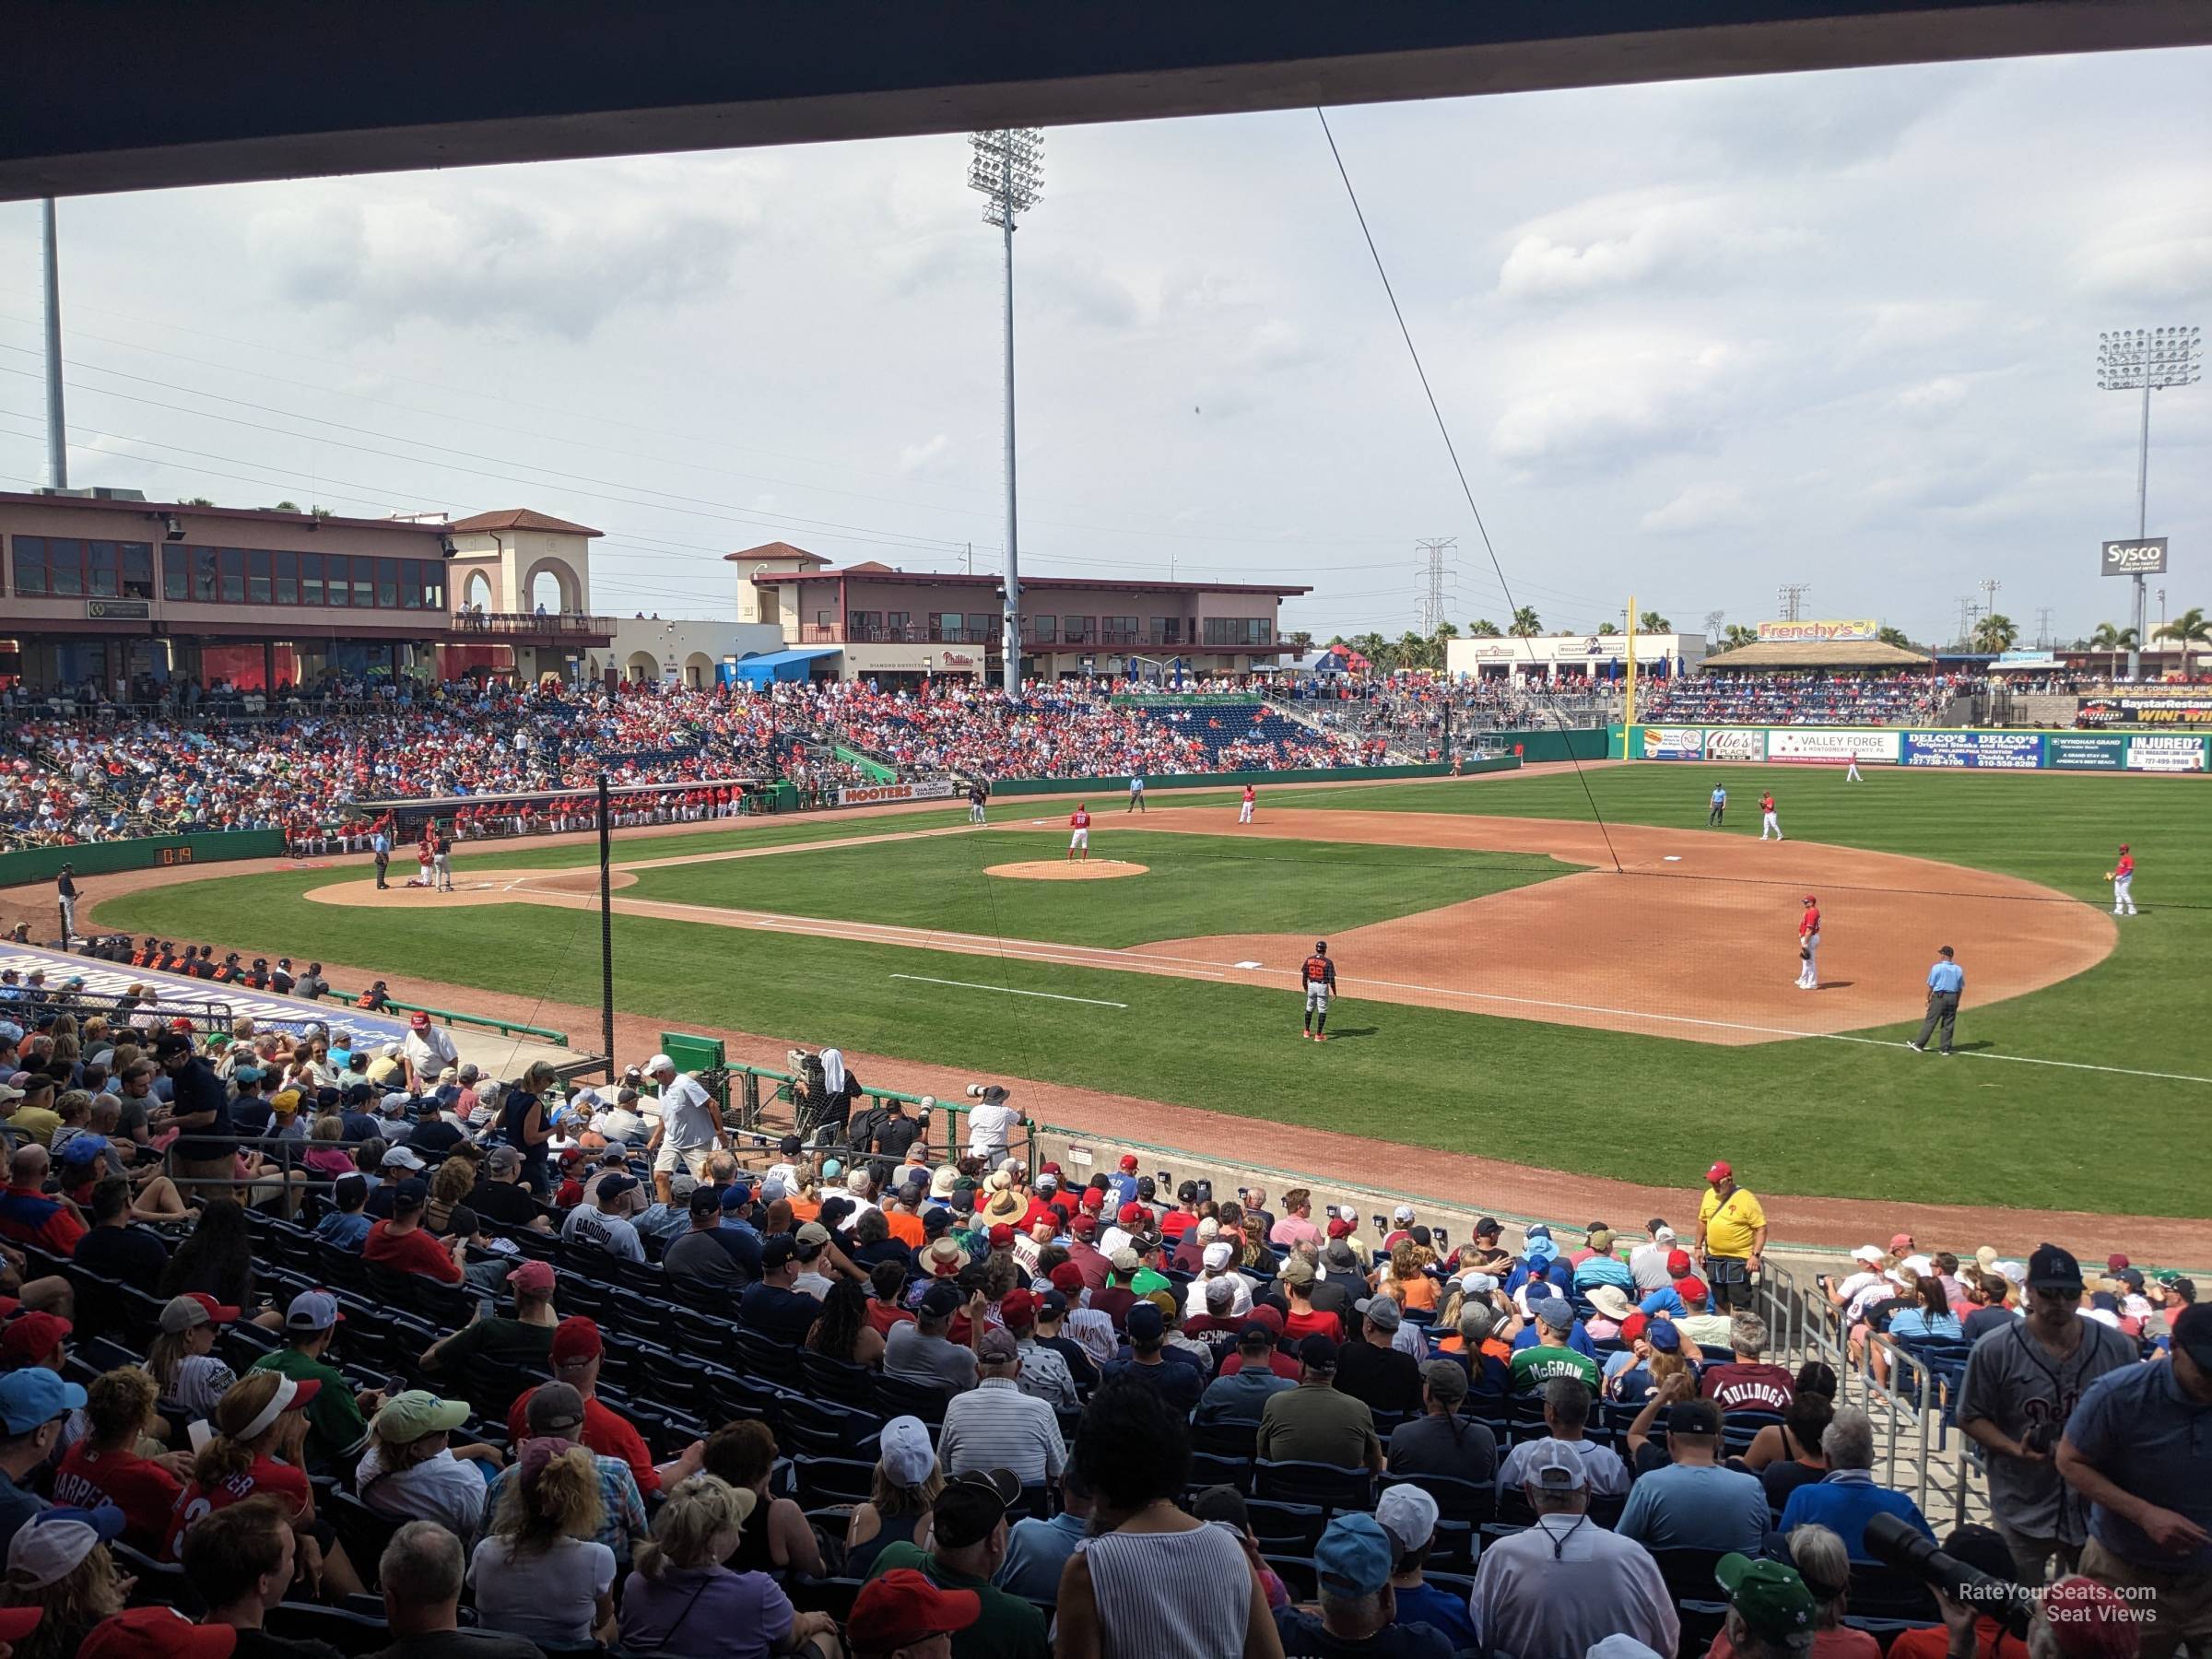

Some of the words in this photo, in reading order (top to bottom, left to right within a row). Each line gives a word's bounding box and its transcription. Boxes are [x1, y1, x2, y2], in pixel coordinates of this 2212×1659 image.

[2108, 545, 2160, 565] Sysco
[1759, 623, 1853, 639] Frenchy's
[942, 651, 974, 665] Phillies
[1707, 730, 1750, 748] Abe's
[1802, 736, 1843, 746] VALLEY
[1847, 737, 1884, 747] FORGE
[1909, 734, 1966, 743] DELCO'S
[1978, 735, 2039, 744] DELCO'S
[2132, 737, 2202, 749] INJURED?
[845, 785, 912, 803] HOOTERS
[1528, 1360, 1584, 1382] McGRAW
[1722, 1382, 1784, 1408] BULLDOGS
